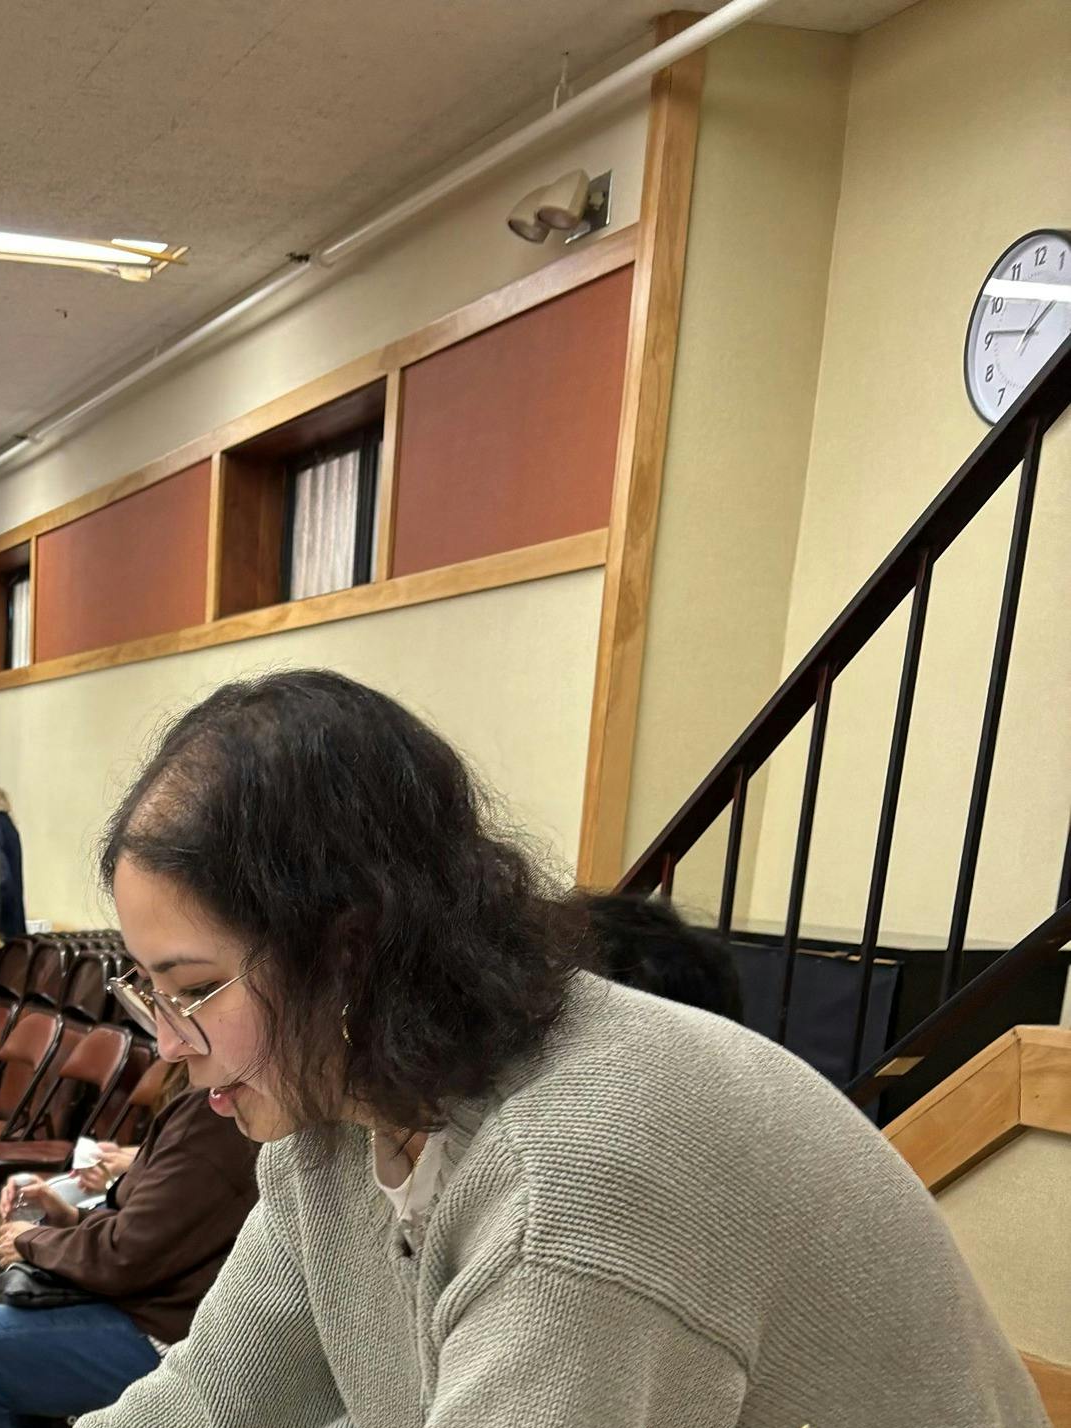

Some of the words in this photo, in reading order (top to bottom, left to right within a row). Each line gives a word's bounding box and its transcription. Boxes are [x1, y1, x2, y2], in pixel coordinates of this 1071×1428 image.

[1034, 246, 1048, 266] 12
[1059, 250, 1066, 271] 1
[1011, 263, 1022, 281] 11
[990, 296, 1003, 316] 10
[984, 332, 994, 351] 9
[984, 364, 994, 383] 8
[996, 387, 1006, 407] 7
